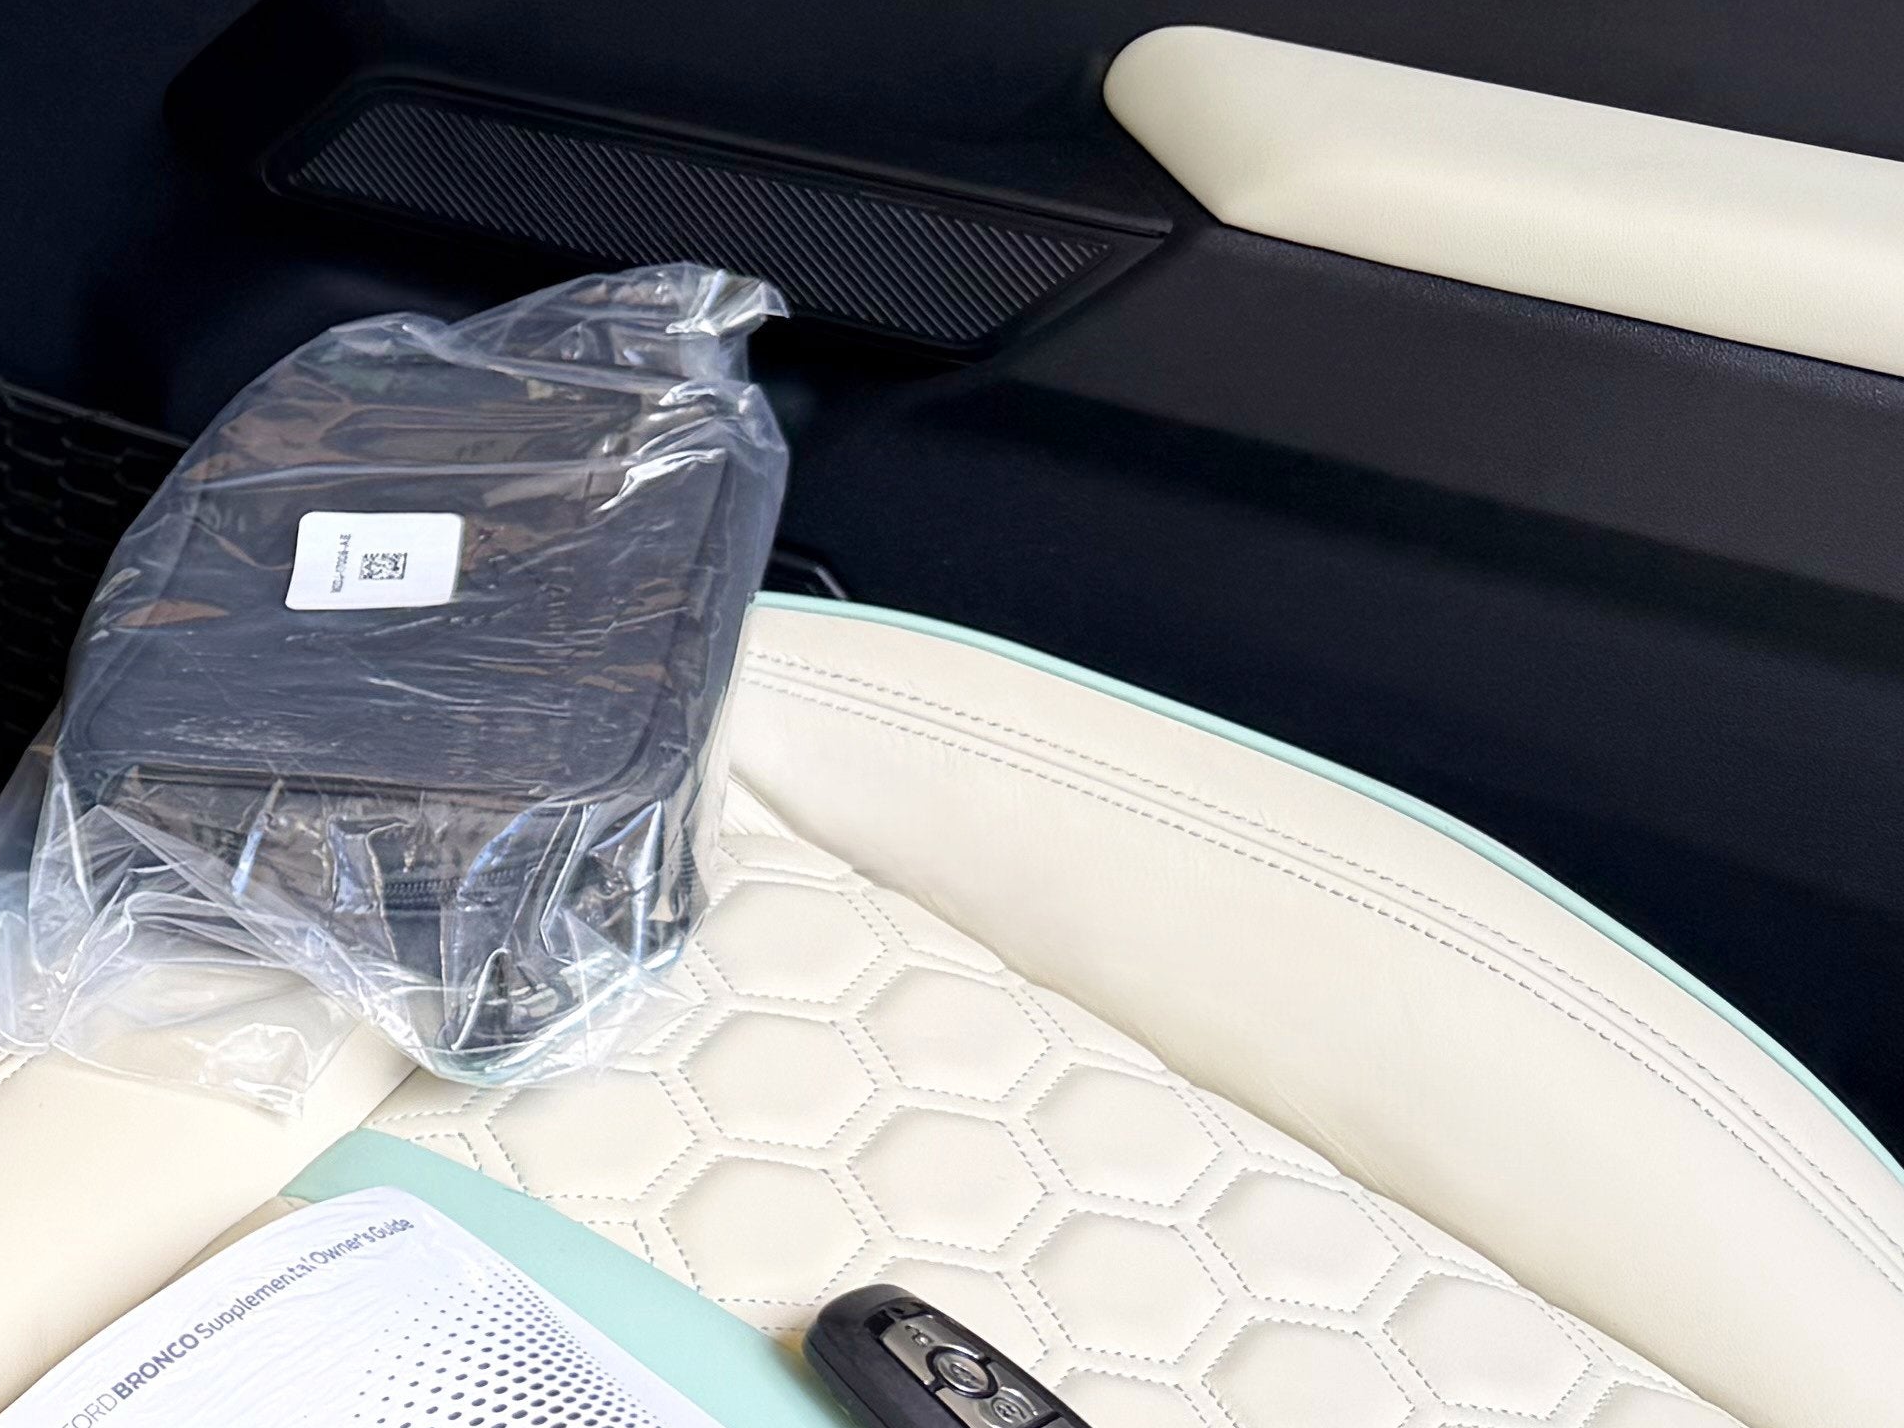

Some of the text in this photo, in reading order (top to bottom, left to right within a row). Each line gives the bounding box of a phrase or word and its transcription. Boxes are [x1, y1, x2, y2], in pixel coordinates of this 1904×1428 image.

[111, 1332, 200, 1400] BRONCO
[194, 1256, 317, 1339] Supplemental
[309, 1230, 377, 1265] Owner's
[368, 1217, 415, 1241] Guide
